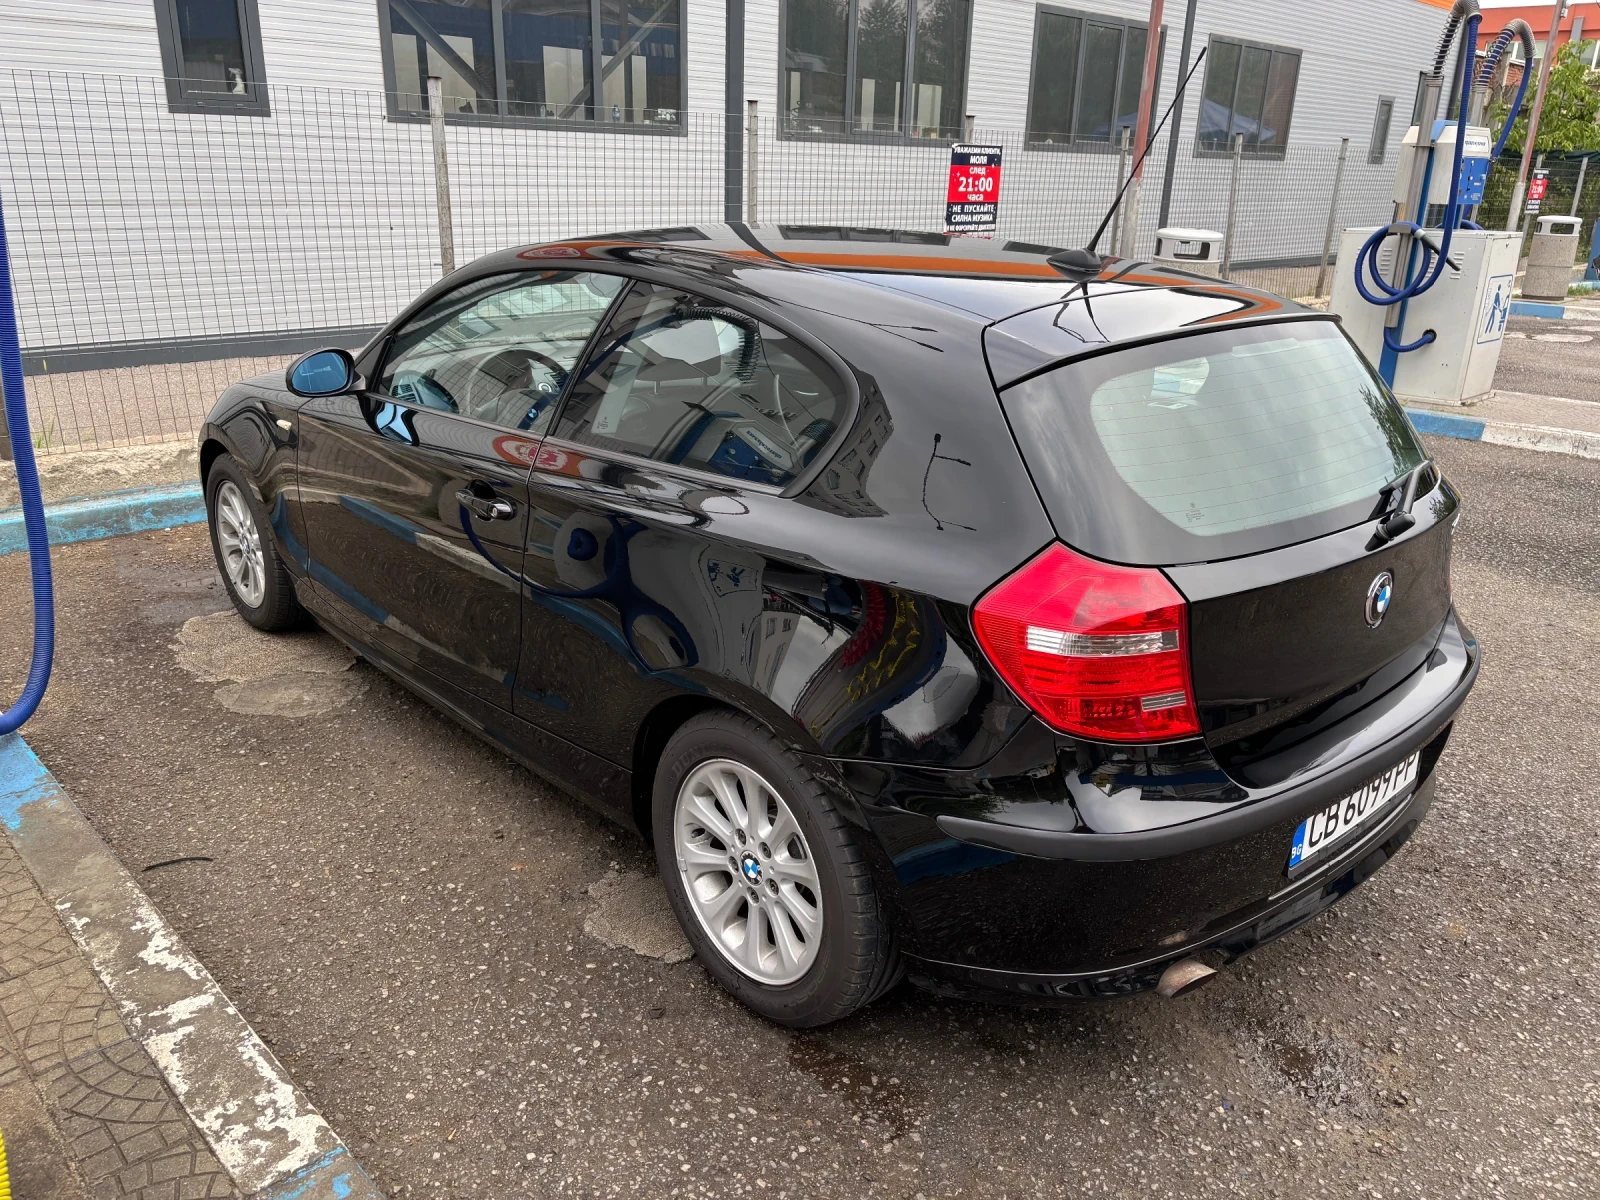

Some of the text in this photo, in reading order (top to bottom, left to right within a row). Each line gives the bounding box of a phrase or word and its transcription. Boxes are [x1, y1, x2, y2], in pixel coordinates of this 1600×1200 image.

[970, 155, 988, 165] МОЛЯ
[969, 166, 986, 176] след
[958, 177, 993, 192] 21:00
[967, 193, 984, 201] часа
[952, 203, 994, 213] НЕ ПУСКАЙТЕ
[951, 214, 972, 222] СИЛНА
[1308, 803, 1340, 848] CB
[1291, 843, 1303, 859] BG
